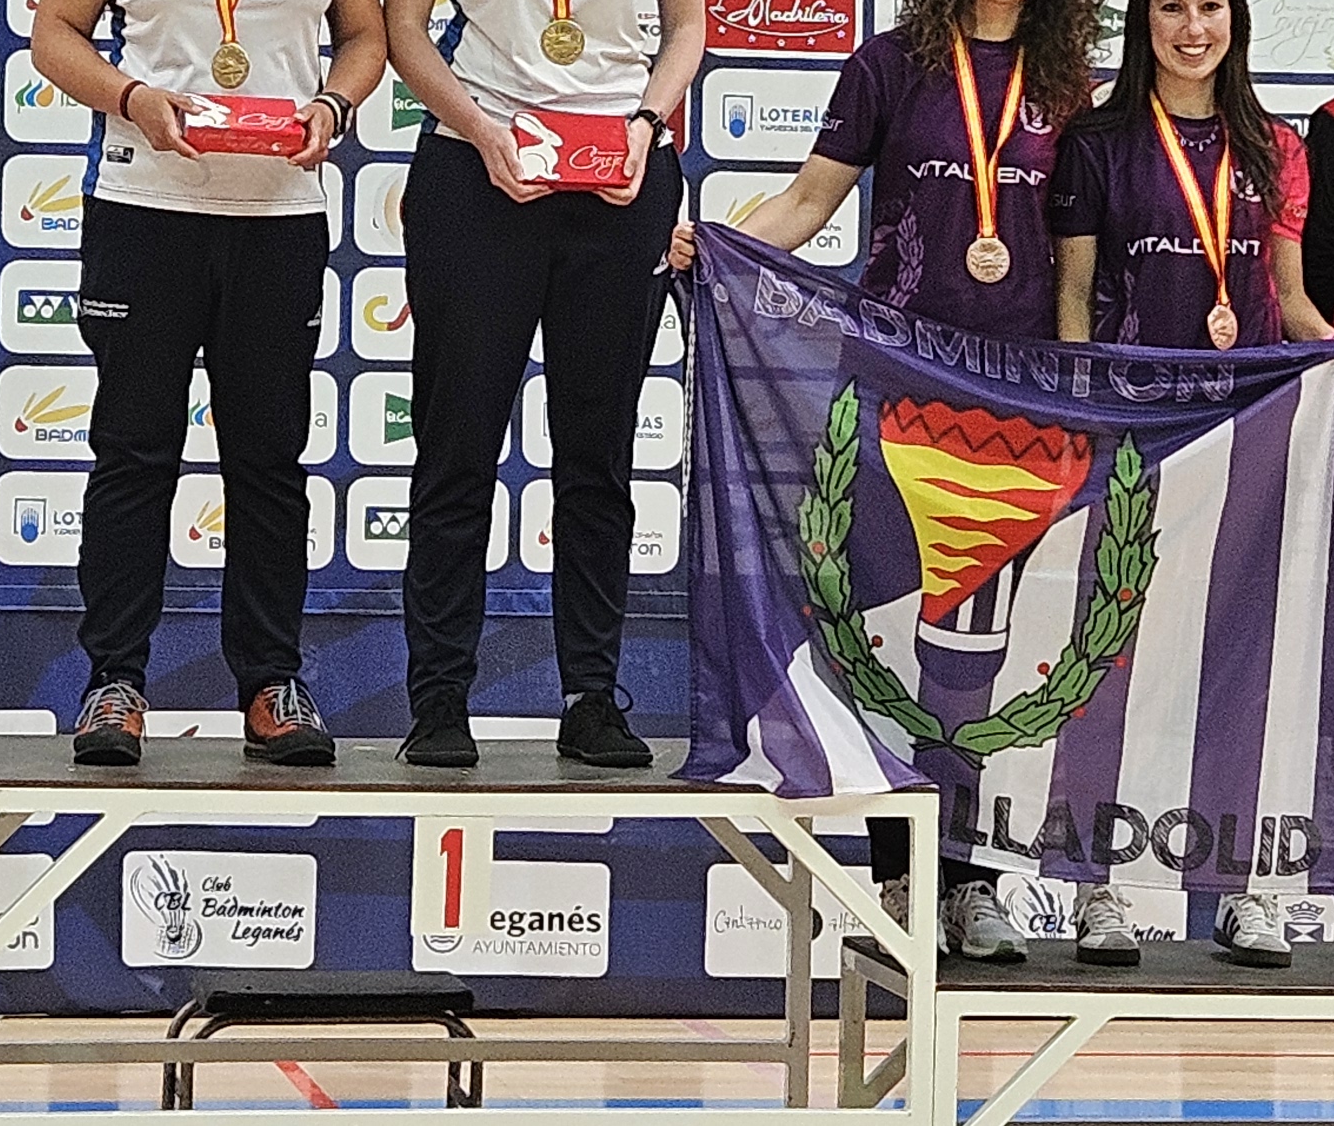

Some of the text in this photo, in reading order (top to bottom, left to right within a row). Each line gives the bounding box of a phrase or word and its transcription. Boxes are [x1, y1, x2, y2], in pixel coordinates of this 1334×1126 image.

[759, 105, 825, 123] LOTERÍ
[907, 159, 1047, 186] VITALENT
[949, 783, 1323, 877] LLADOLID
[202, 875, 233, 893] Club
[439, 827, 464, 930] 1
[154, 890, 192, 911] CBL
[201, 893, 305, 919] Bádminton
[232, 919, 305, 945] Leganés
[489, 905, 602, 940] eganés
[471, 937, 602, 957] AYUNTAMIENTO
